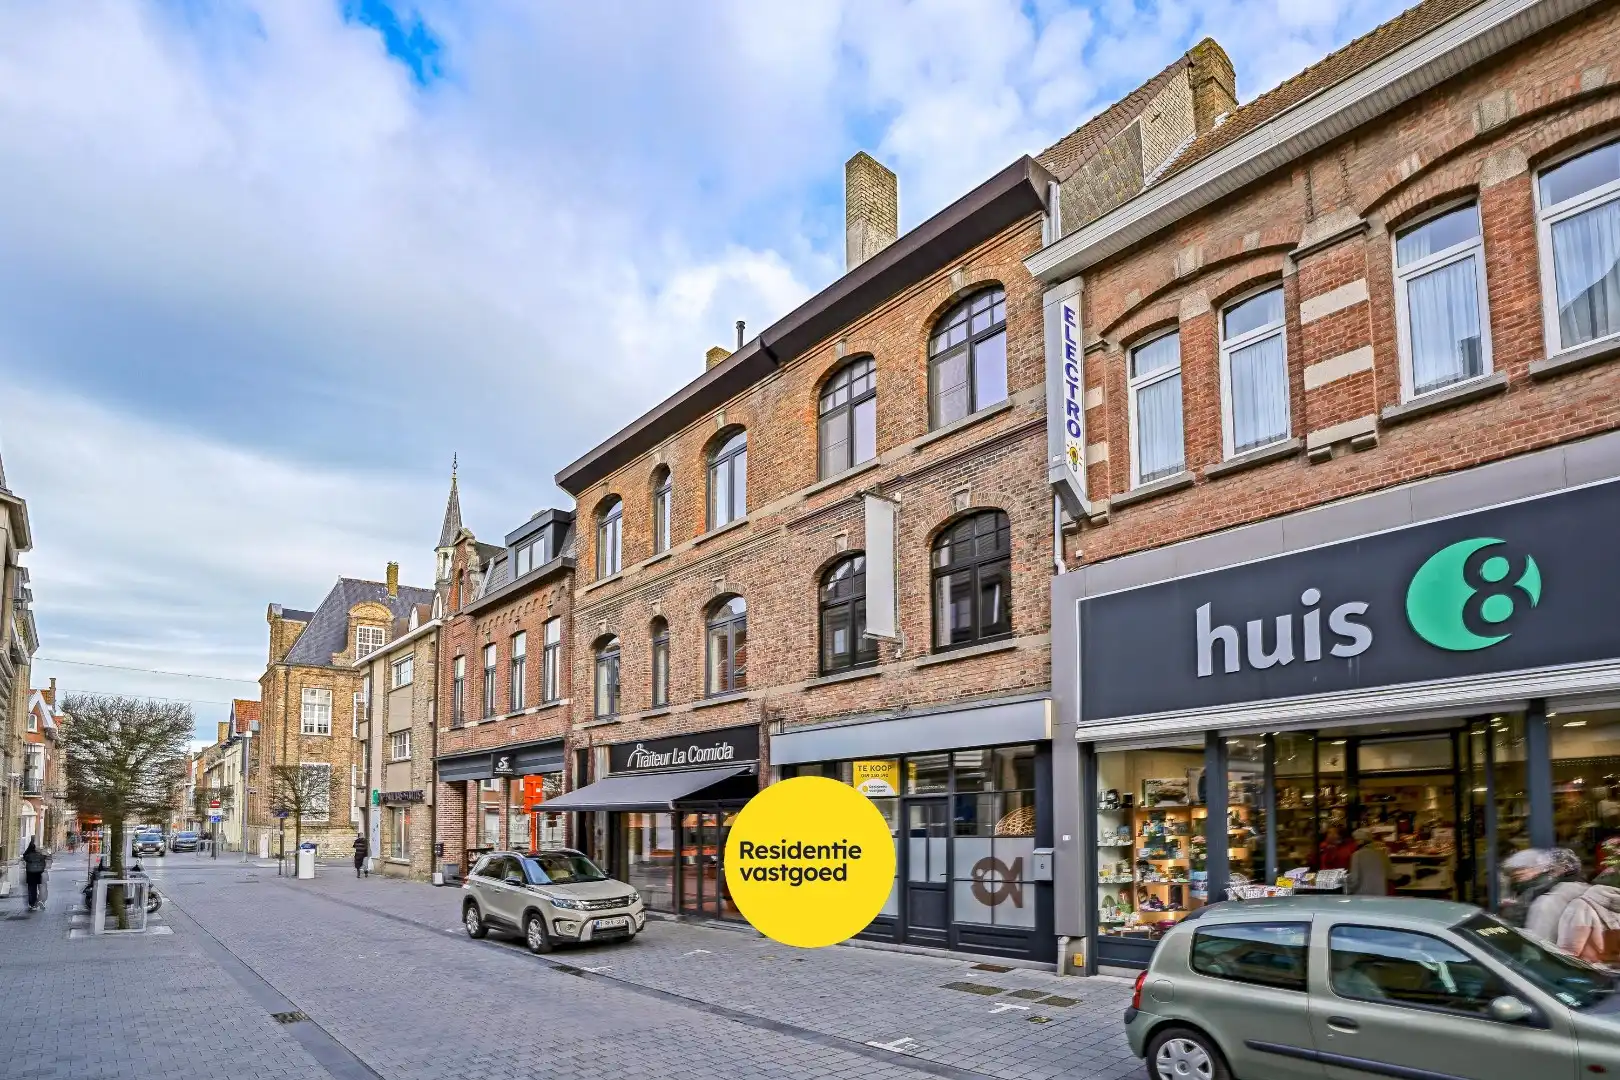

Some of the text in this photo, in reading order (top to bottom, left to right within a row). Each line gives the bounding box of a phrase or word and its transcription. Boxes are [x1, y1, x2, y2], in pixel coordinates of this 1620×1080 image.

[1063, 304, 1082, 439] ELECTRO
[1196, 588, 1373, 677] huis
[636, 742, 734, 768] Traiteur La Comida
[870, 764, 893, 772] KOOP
